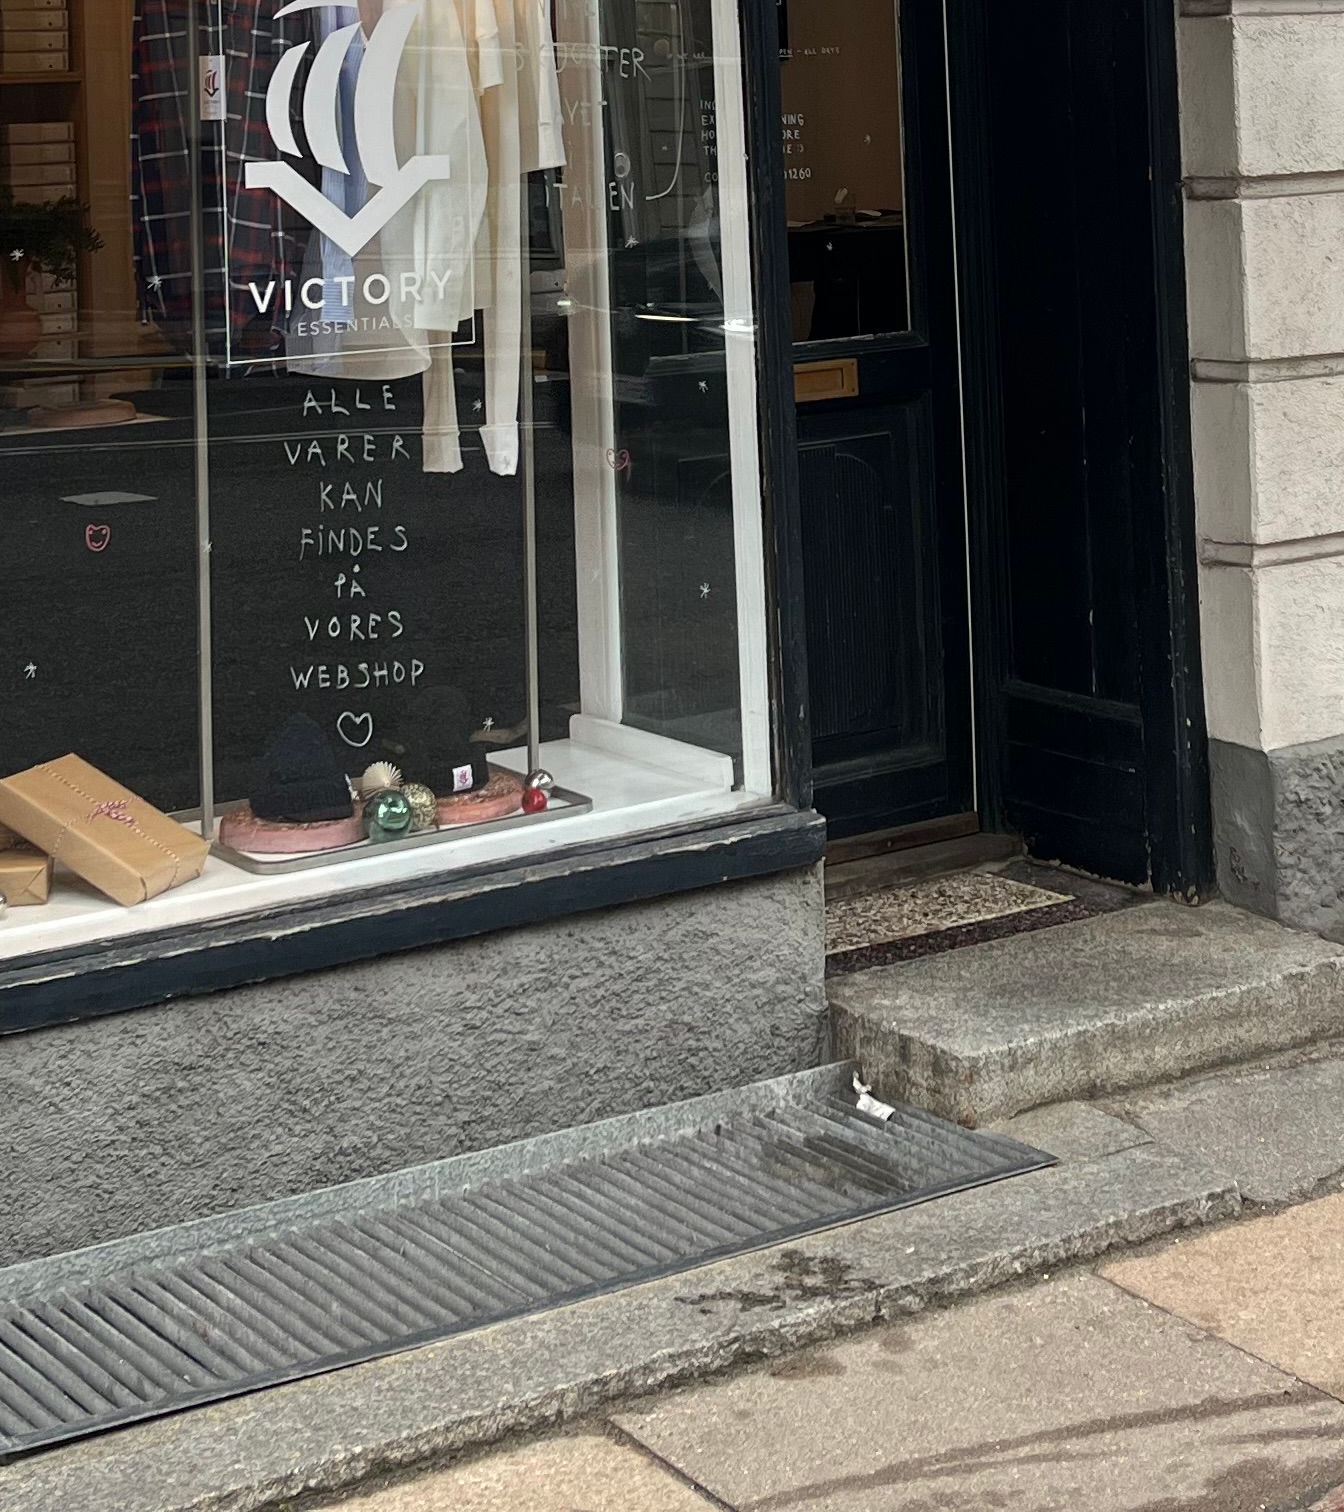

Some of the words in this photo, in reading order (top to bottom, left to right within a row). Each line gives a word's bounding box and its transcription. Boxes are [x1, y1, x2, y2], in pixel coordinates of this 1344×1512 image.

[248, 269, 453, 314] VICTORY
[297, 314, 415, 337] ESSENTIALS
[302, 384, 397, 417] ALLE
[283, 433, 411, 467] VARER
[318, 478, 384, 513] KAN
[333, 564, 366, 600] PÅ
[304, 609, 405, 643] VORES
[290, 658, 426, 690] WEBSHOP
